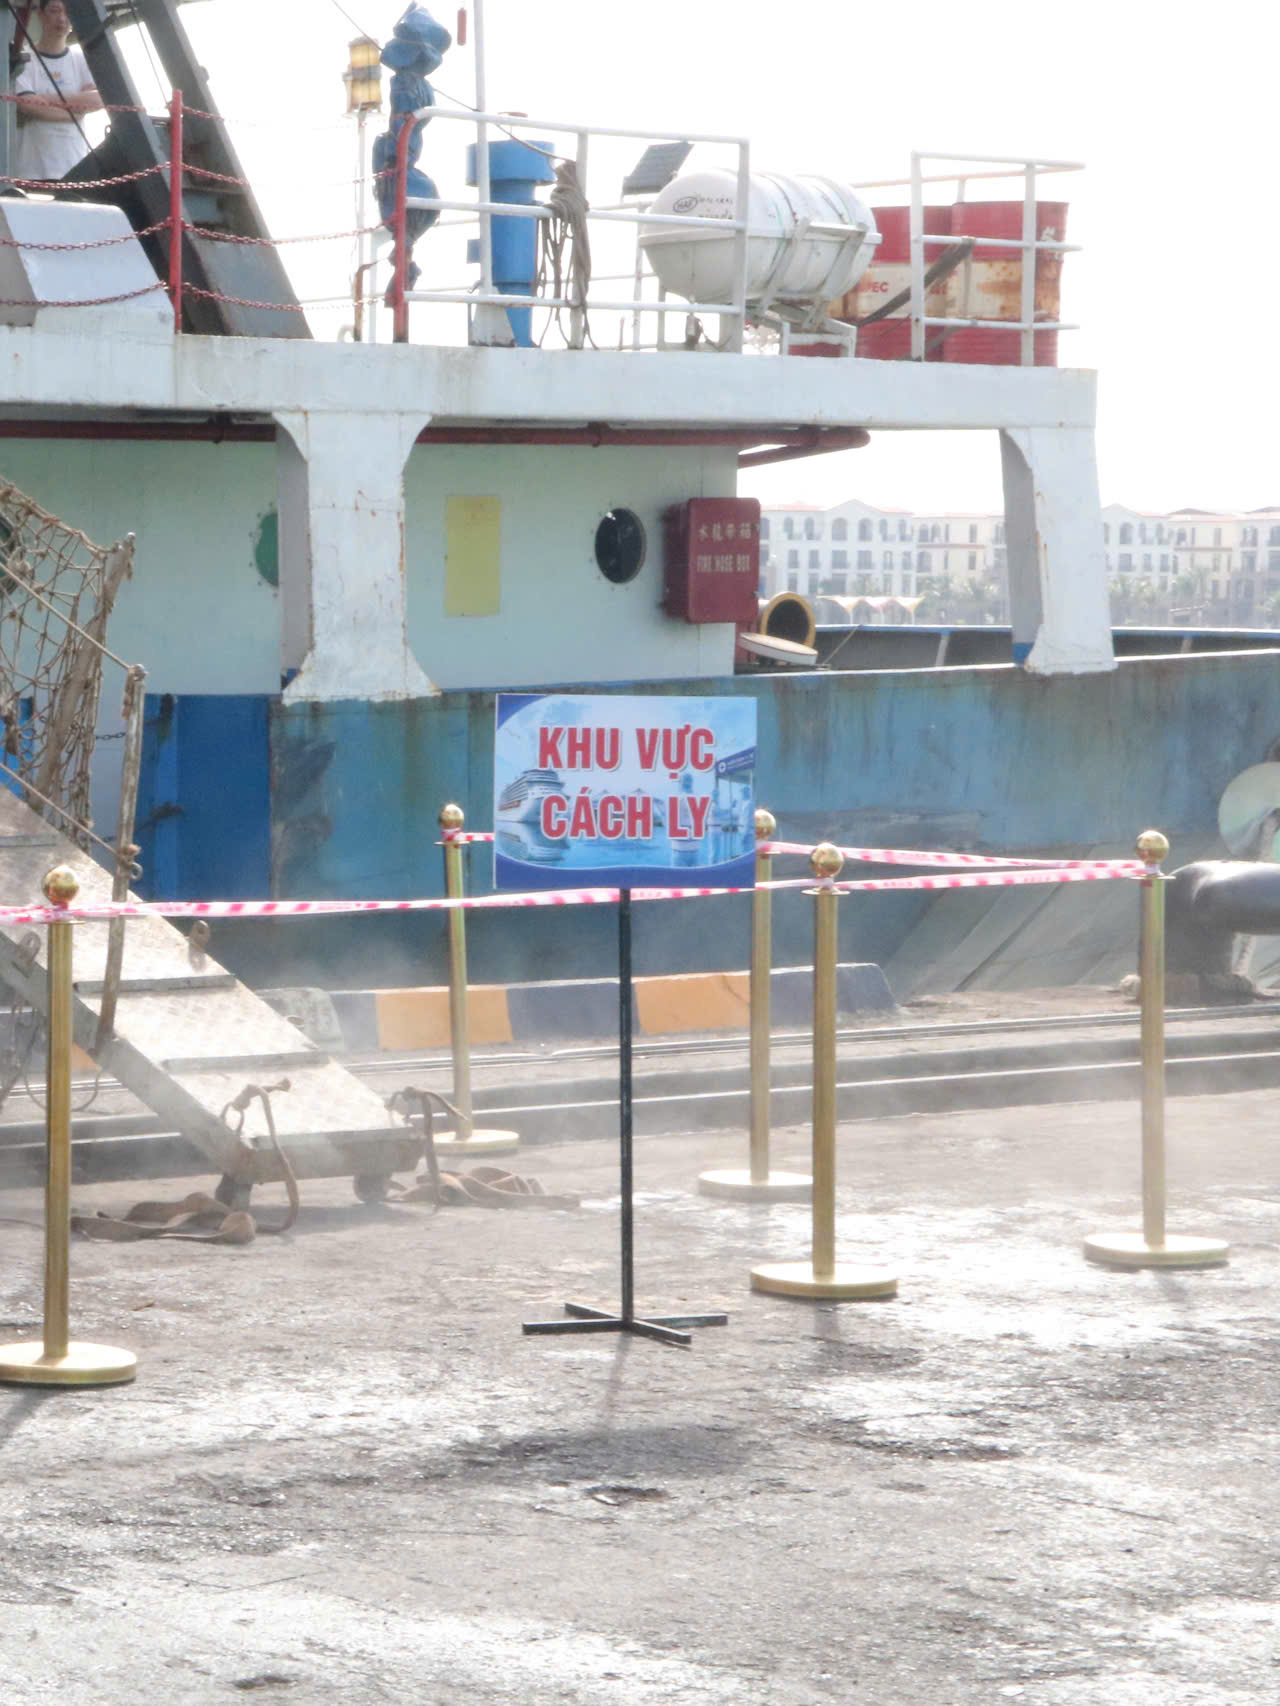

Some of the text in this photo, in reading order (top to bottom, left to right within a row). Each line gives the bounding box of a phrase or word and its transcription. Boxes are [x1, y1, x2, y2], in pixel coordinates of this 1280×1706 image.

[538, 723, 714, 780] KHU VỰC
[542, 786, 711, 838] CÁCH LY
